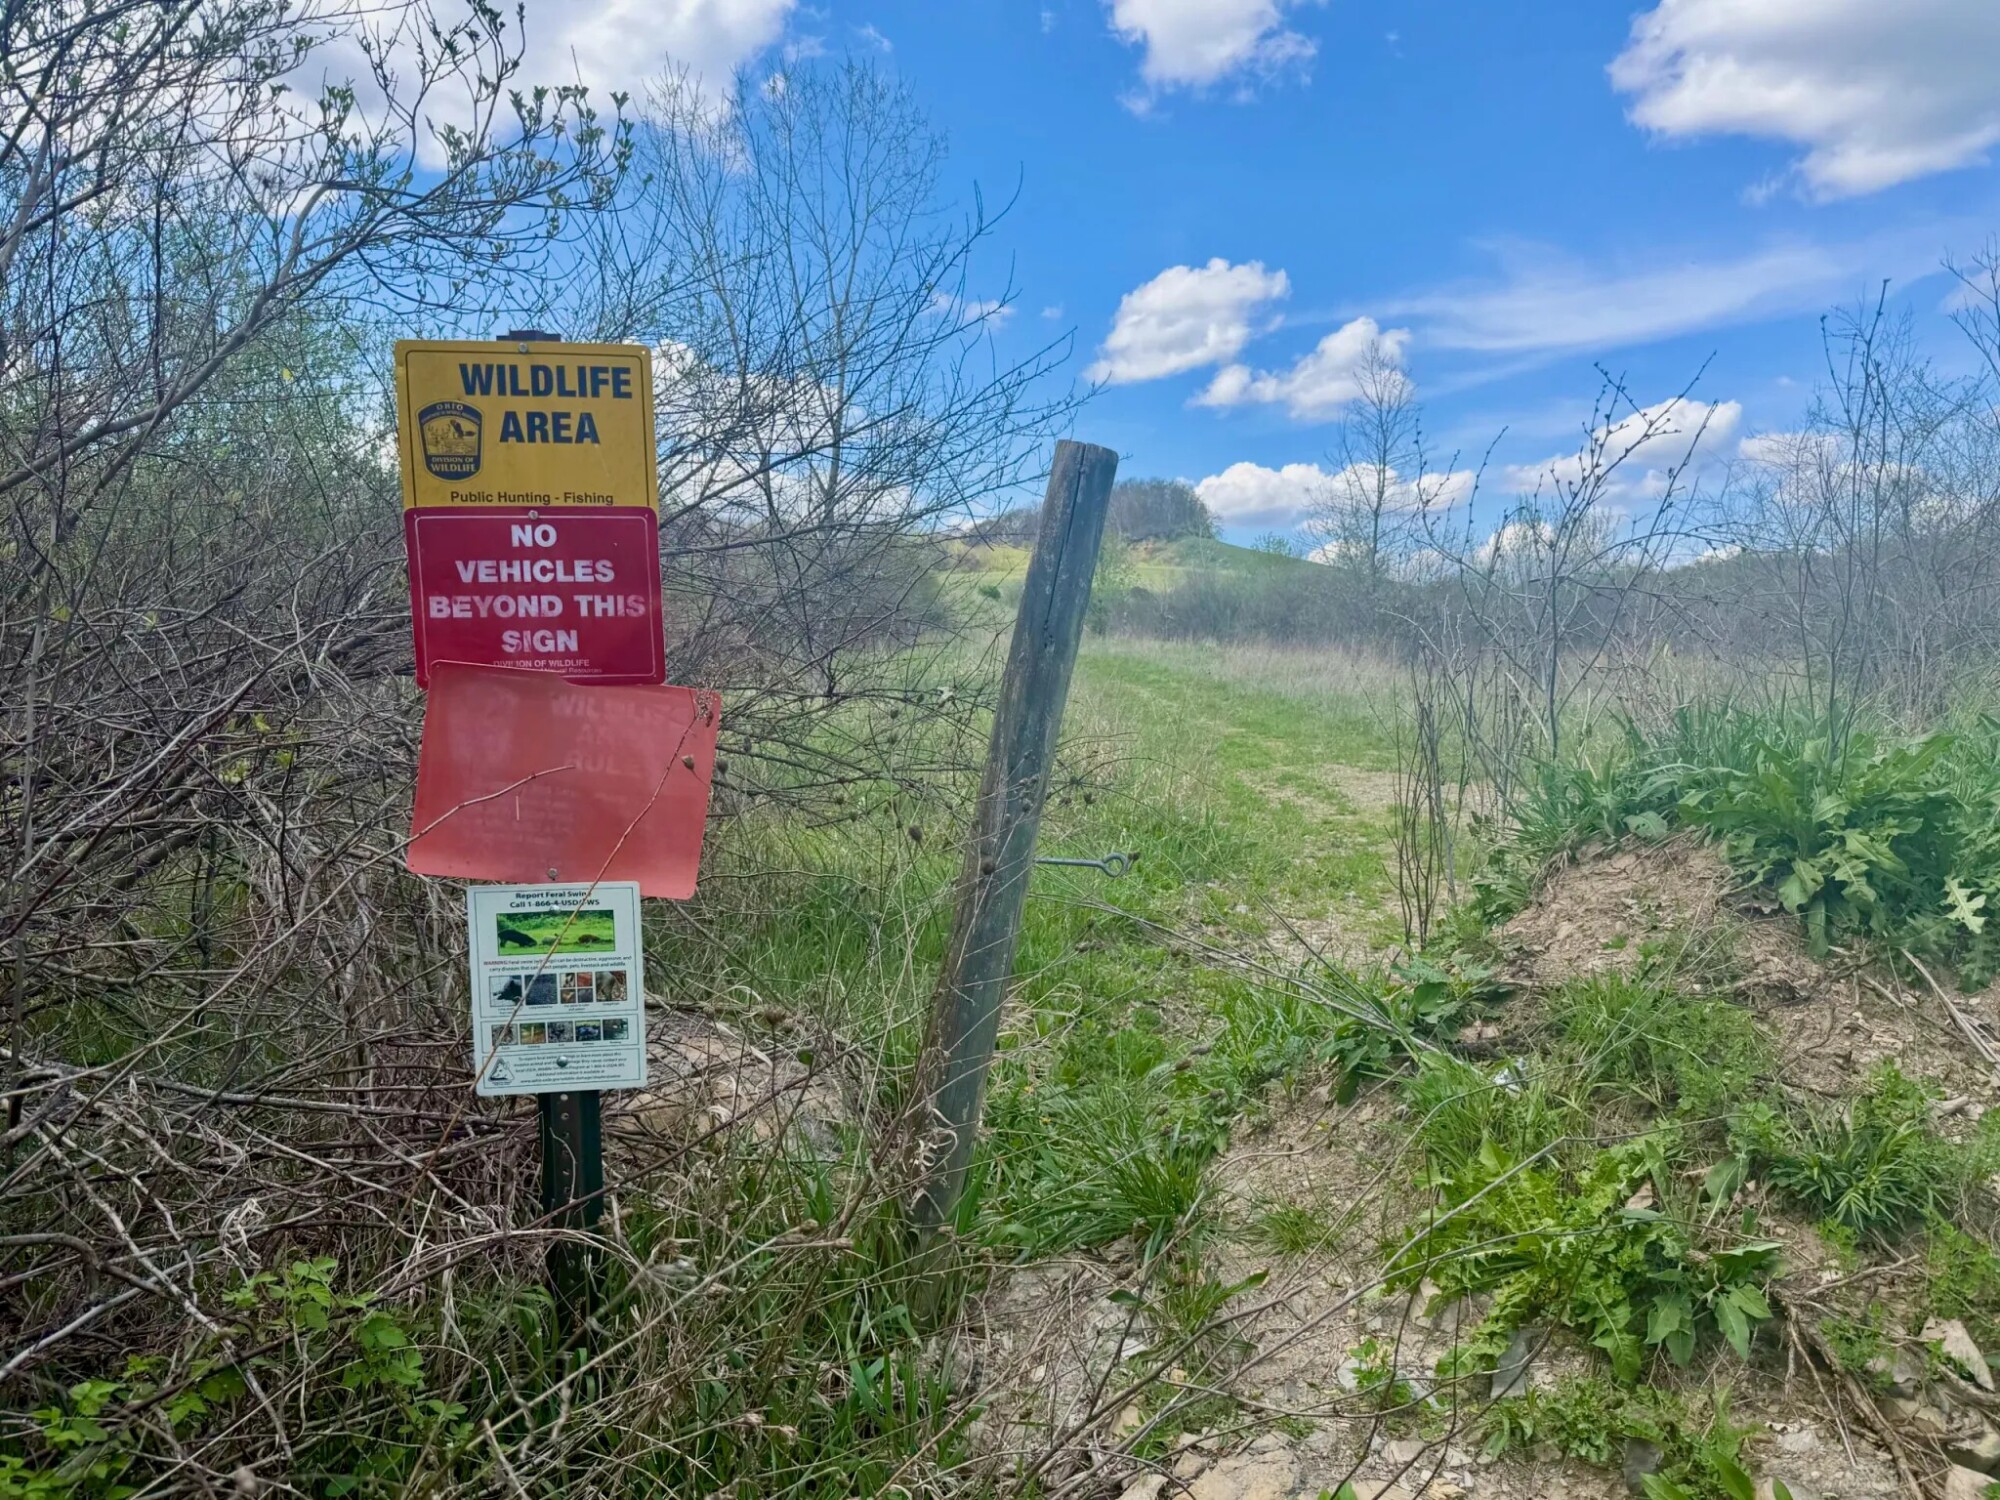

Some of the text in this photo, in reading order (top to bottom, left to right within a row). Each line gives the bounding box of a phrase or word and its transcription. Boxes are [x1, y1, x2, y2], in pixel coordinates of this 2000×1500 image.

[458, 363, 632, 399] WILDLIFE
[436, 403, 463, 411] OHIO
[499, 411, 601, 444] AREA
[431, 463, 476, 472] WILDLIFE
[450, 491, 493, 503] Public
[497, 492, 551, 505] Hunting
[563, 492, 614, 506] Fishing
[511, 524, 557, 547] NO
[455, 560, 615, 583] VEHICLES
[428, 595, 646, 618] BEYOND THIS
[501, 630, 578, 653] SIGN
[493, 660, 532, 668] DIVIION
[548, 659, 590, 667] WILDLIFE
[515, 891, 544, 900] Report
[545, 890, 566, 898] Feral
